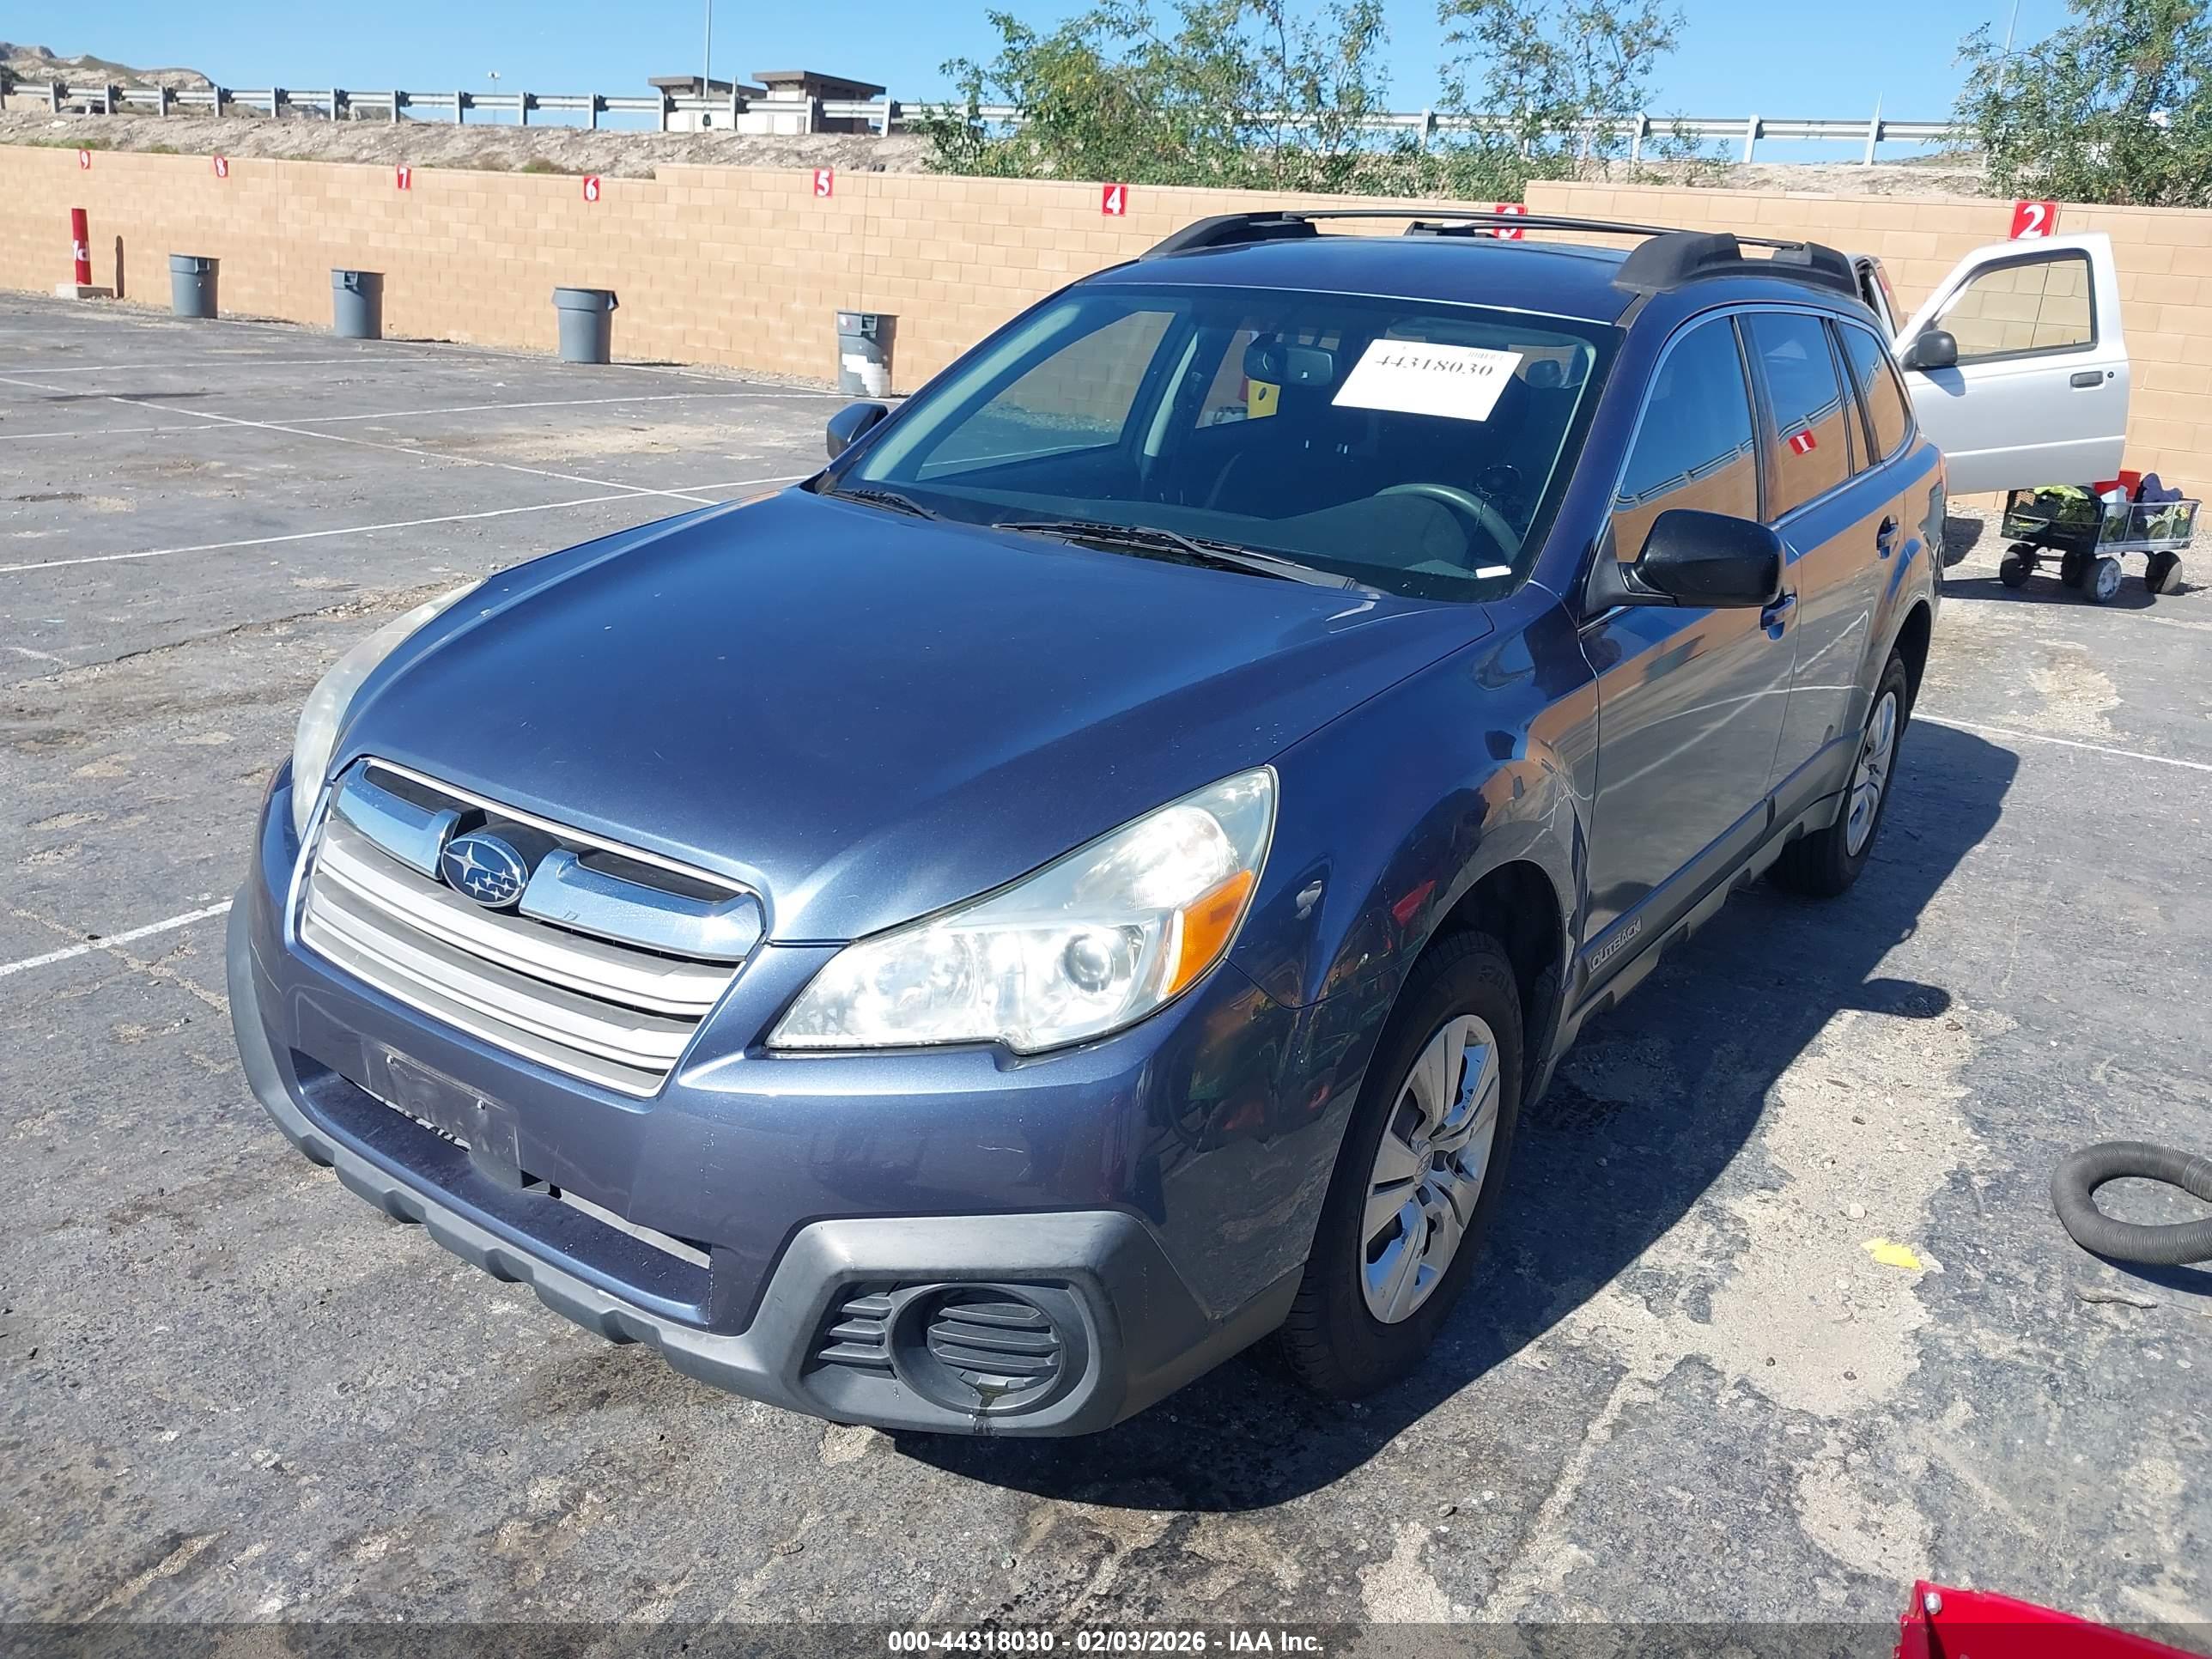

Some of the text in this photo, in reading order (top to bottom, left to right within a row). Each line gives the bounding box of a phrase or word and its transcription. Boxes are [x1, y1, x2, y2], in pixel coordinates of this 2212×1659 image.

[81, 150, 88, 169] 9
[216, 157, 226, 177] 8
[399, 167, 408, 190] 7
[586, 178, 597, 201] 6
[817, 170, 830, 197] 5
[1106, 185, 1121, 215] 4
[2017, 204, 2046, 239] 2
[1375, 355, 1493, 377] 44318030
